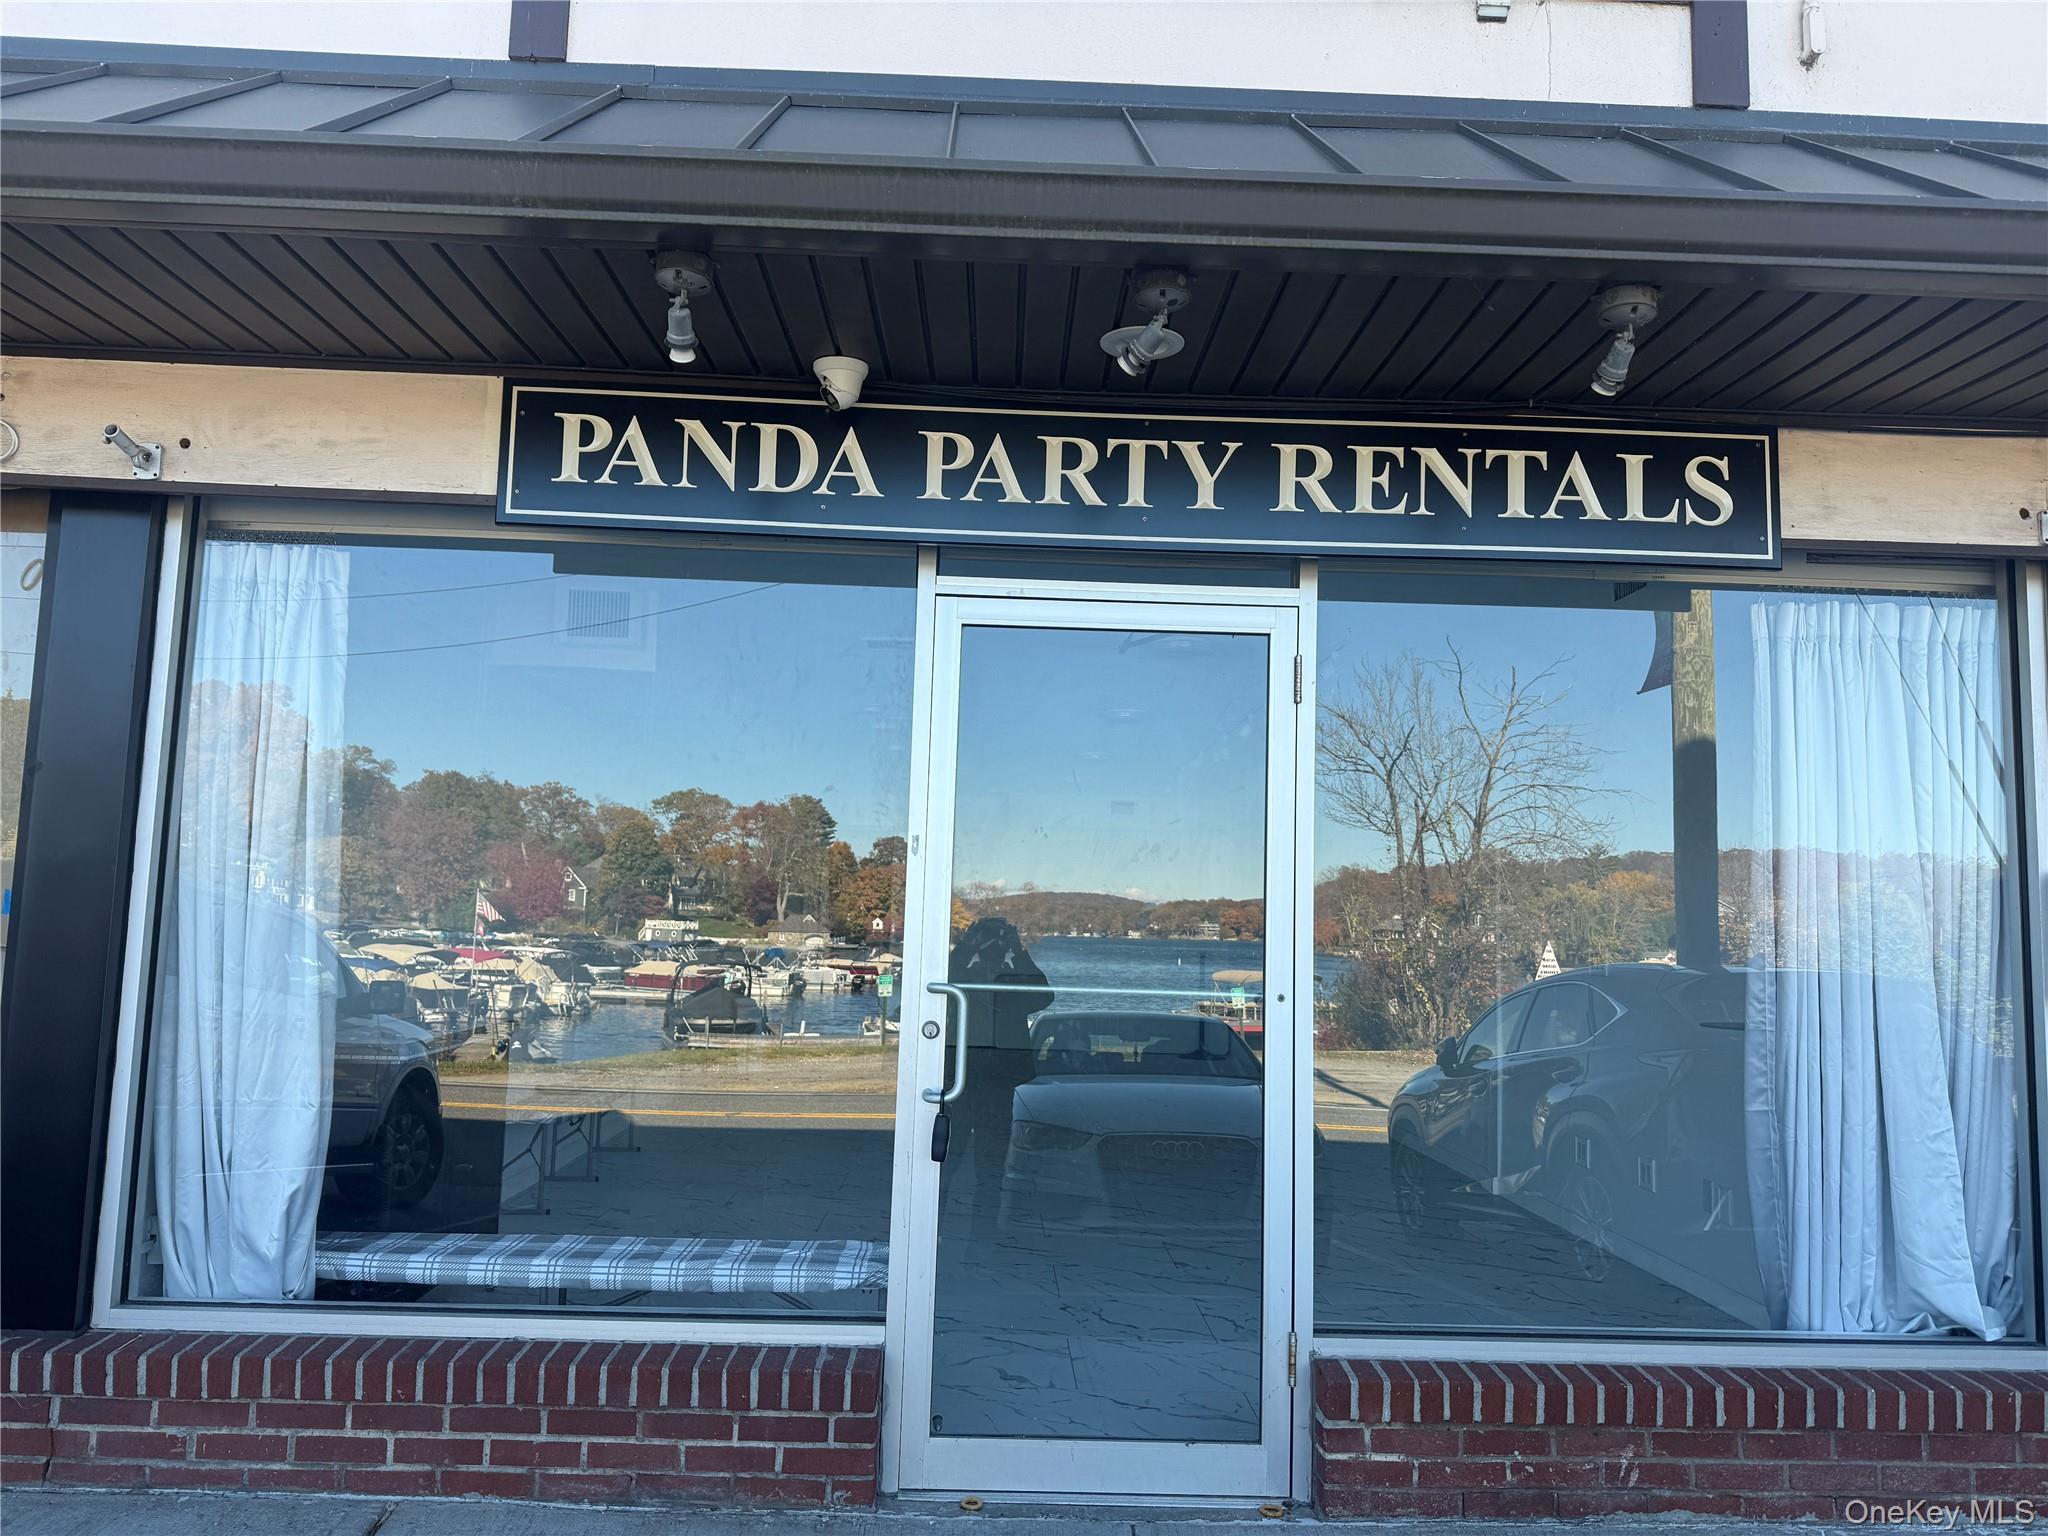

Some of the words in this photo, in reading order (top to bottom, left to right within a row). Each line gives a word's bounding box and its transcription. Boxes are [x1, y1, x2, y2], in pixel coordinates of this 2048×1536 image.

[551, 412, 885, 497] PANDA
[916, 430, 1243, 510] PARTY
[1269, 443, 1734, 527] RENTALS
